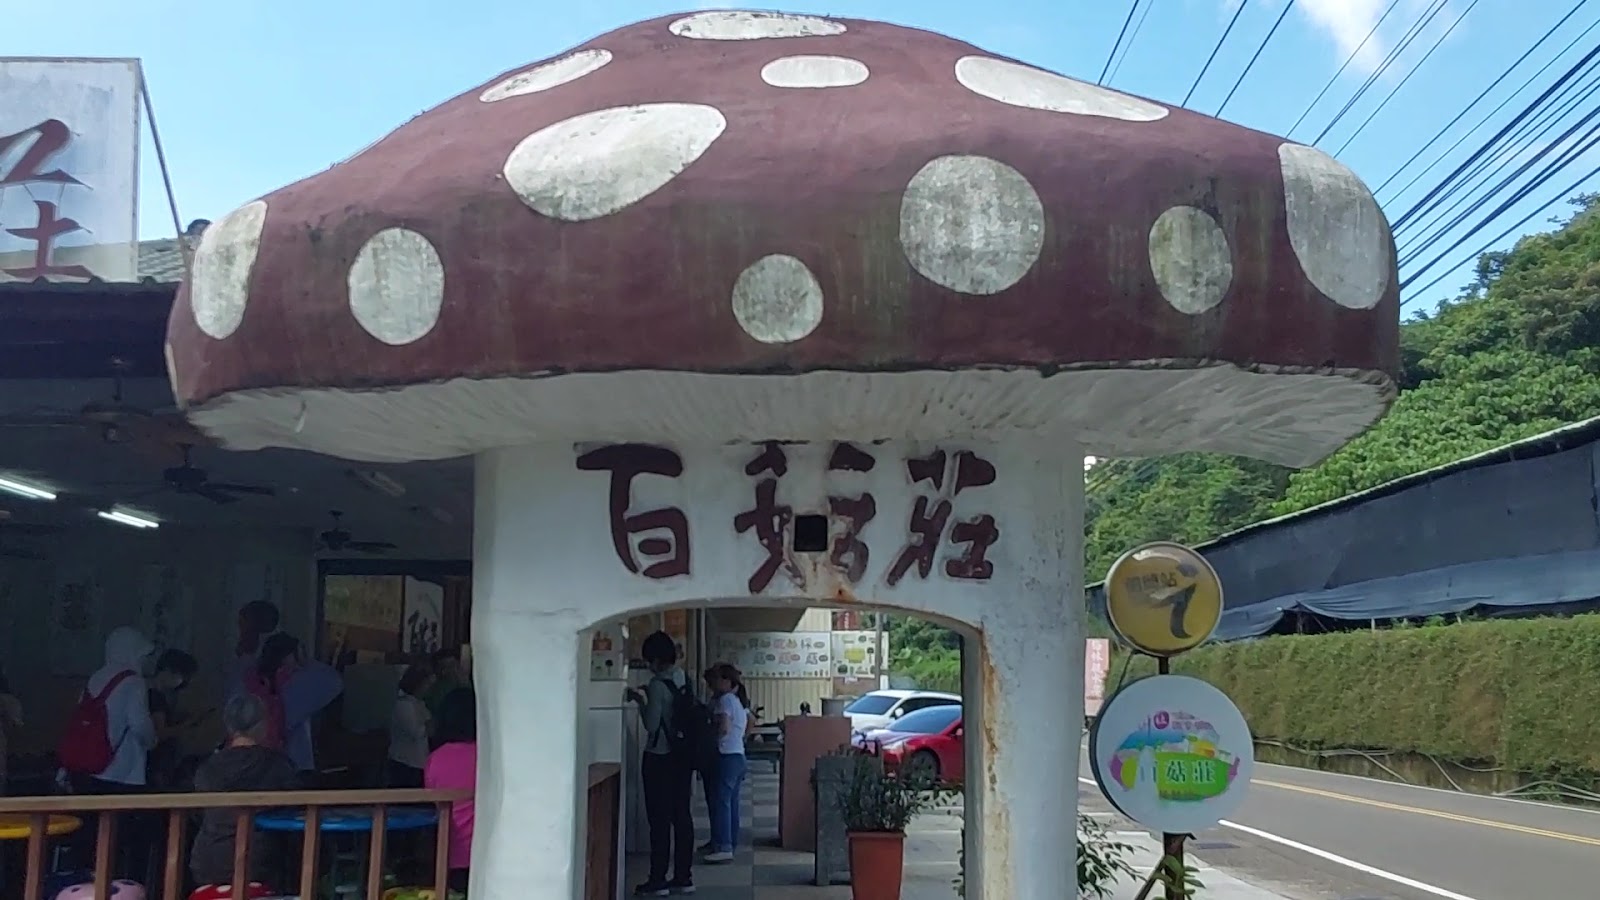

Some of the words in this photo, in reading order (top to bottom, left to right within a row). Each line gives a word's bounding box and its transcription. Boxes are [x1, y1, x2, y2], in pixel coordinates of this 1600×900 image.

[576, 442, 998, 593] 百菇莊
[1140, 759, 1217, 784] 菇莊
